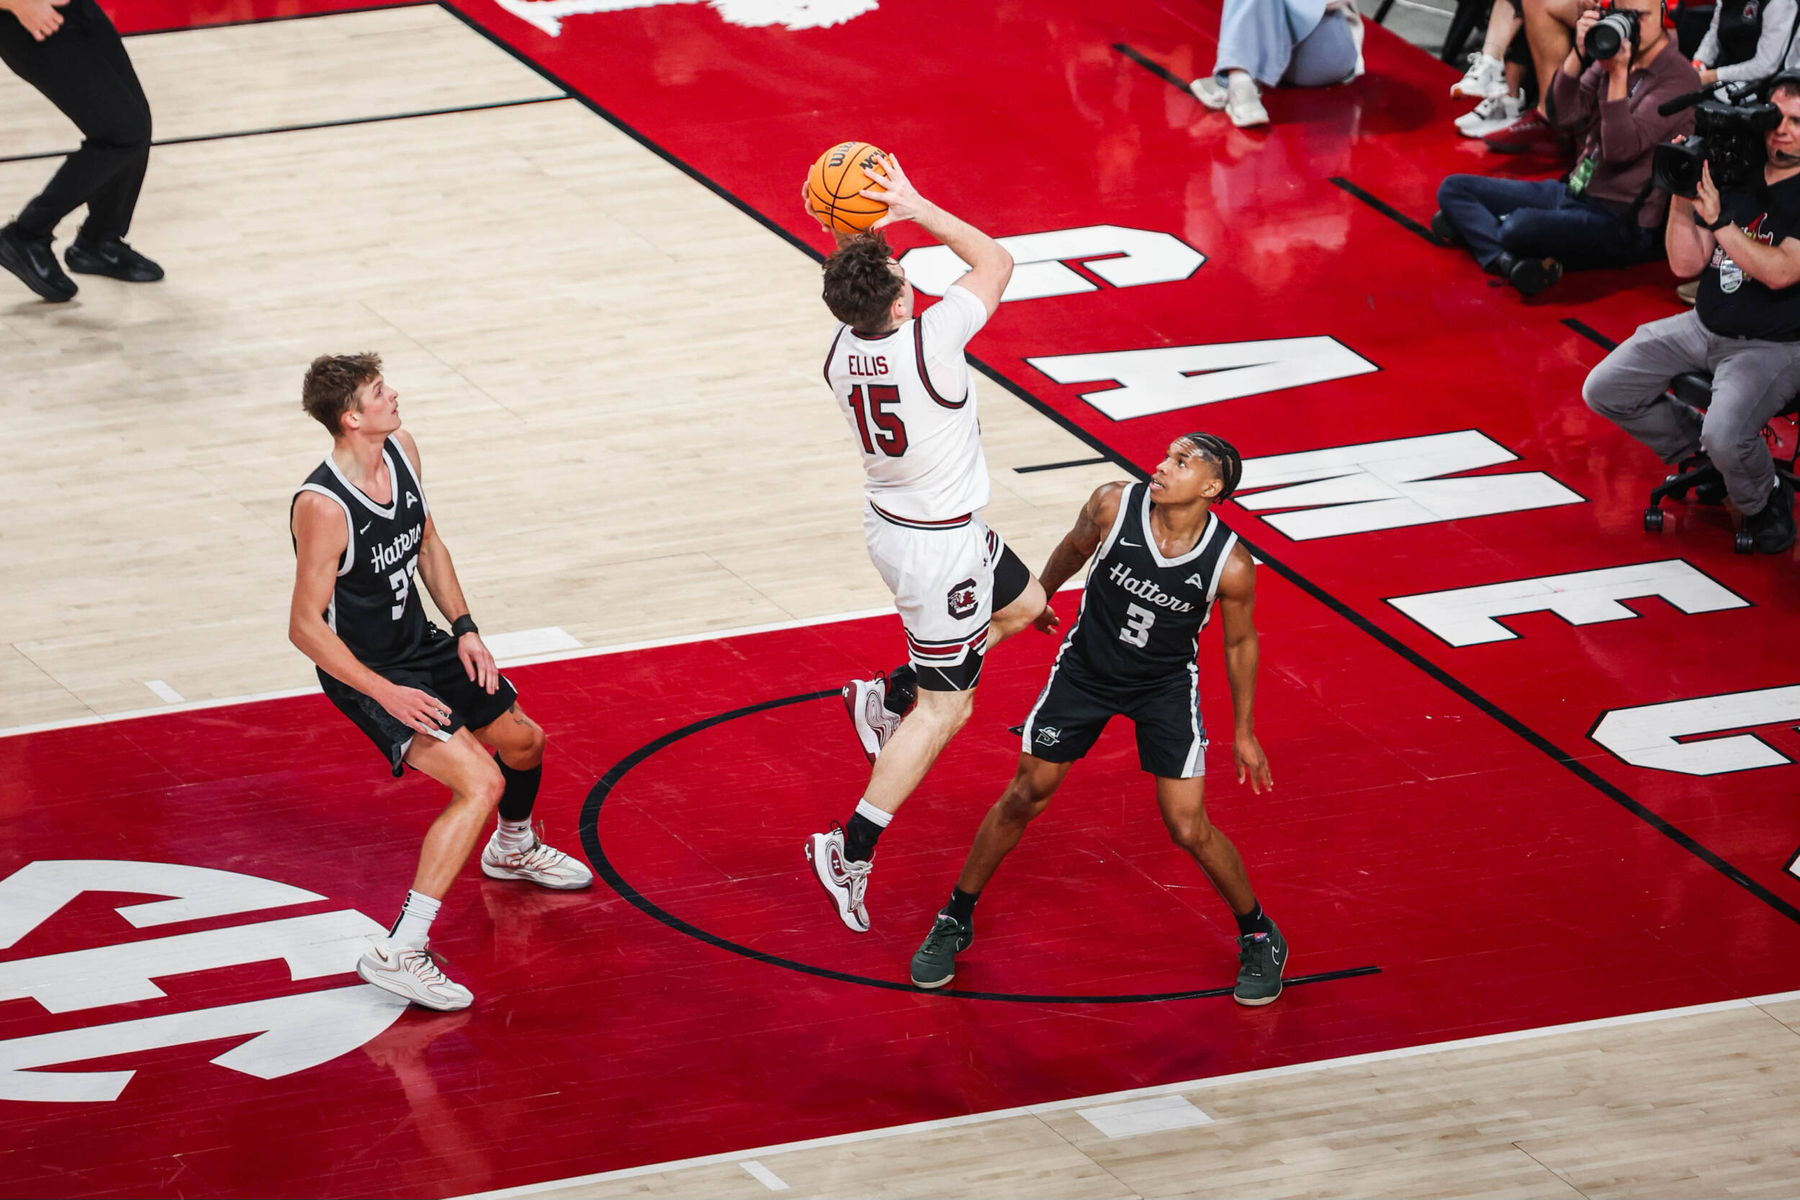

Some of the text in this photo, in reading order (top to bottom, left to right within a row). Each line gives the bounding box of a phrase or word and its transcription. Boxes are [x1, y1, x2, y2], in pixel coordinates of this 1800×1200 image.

[848, 355, 889, 376] ELLIS
[848, 384, 909, 457] 15
[898, 223, 1800, 881] GAMEC
[1109, 562, 1195, 613] Hatters
[1119, 602, 1156, 649] 3
